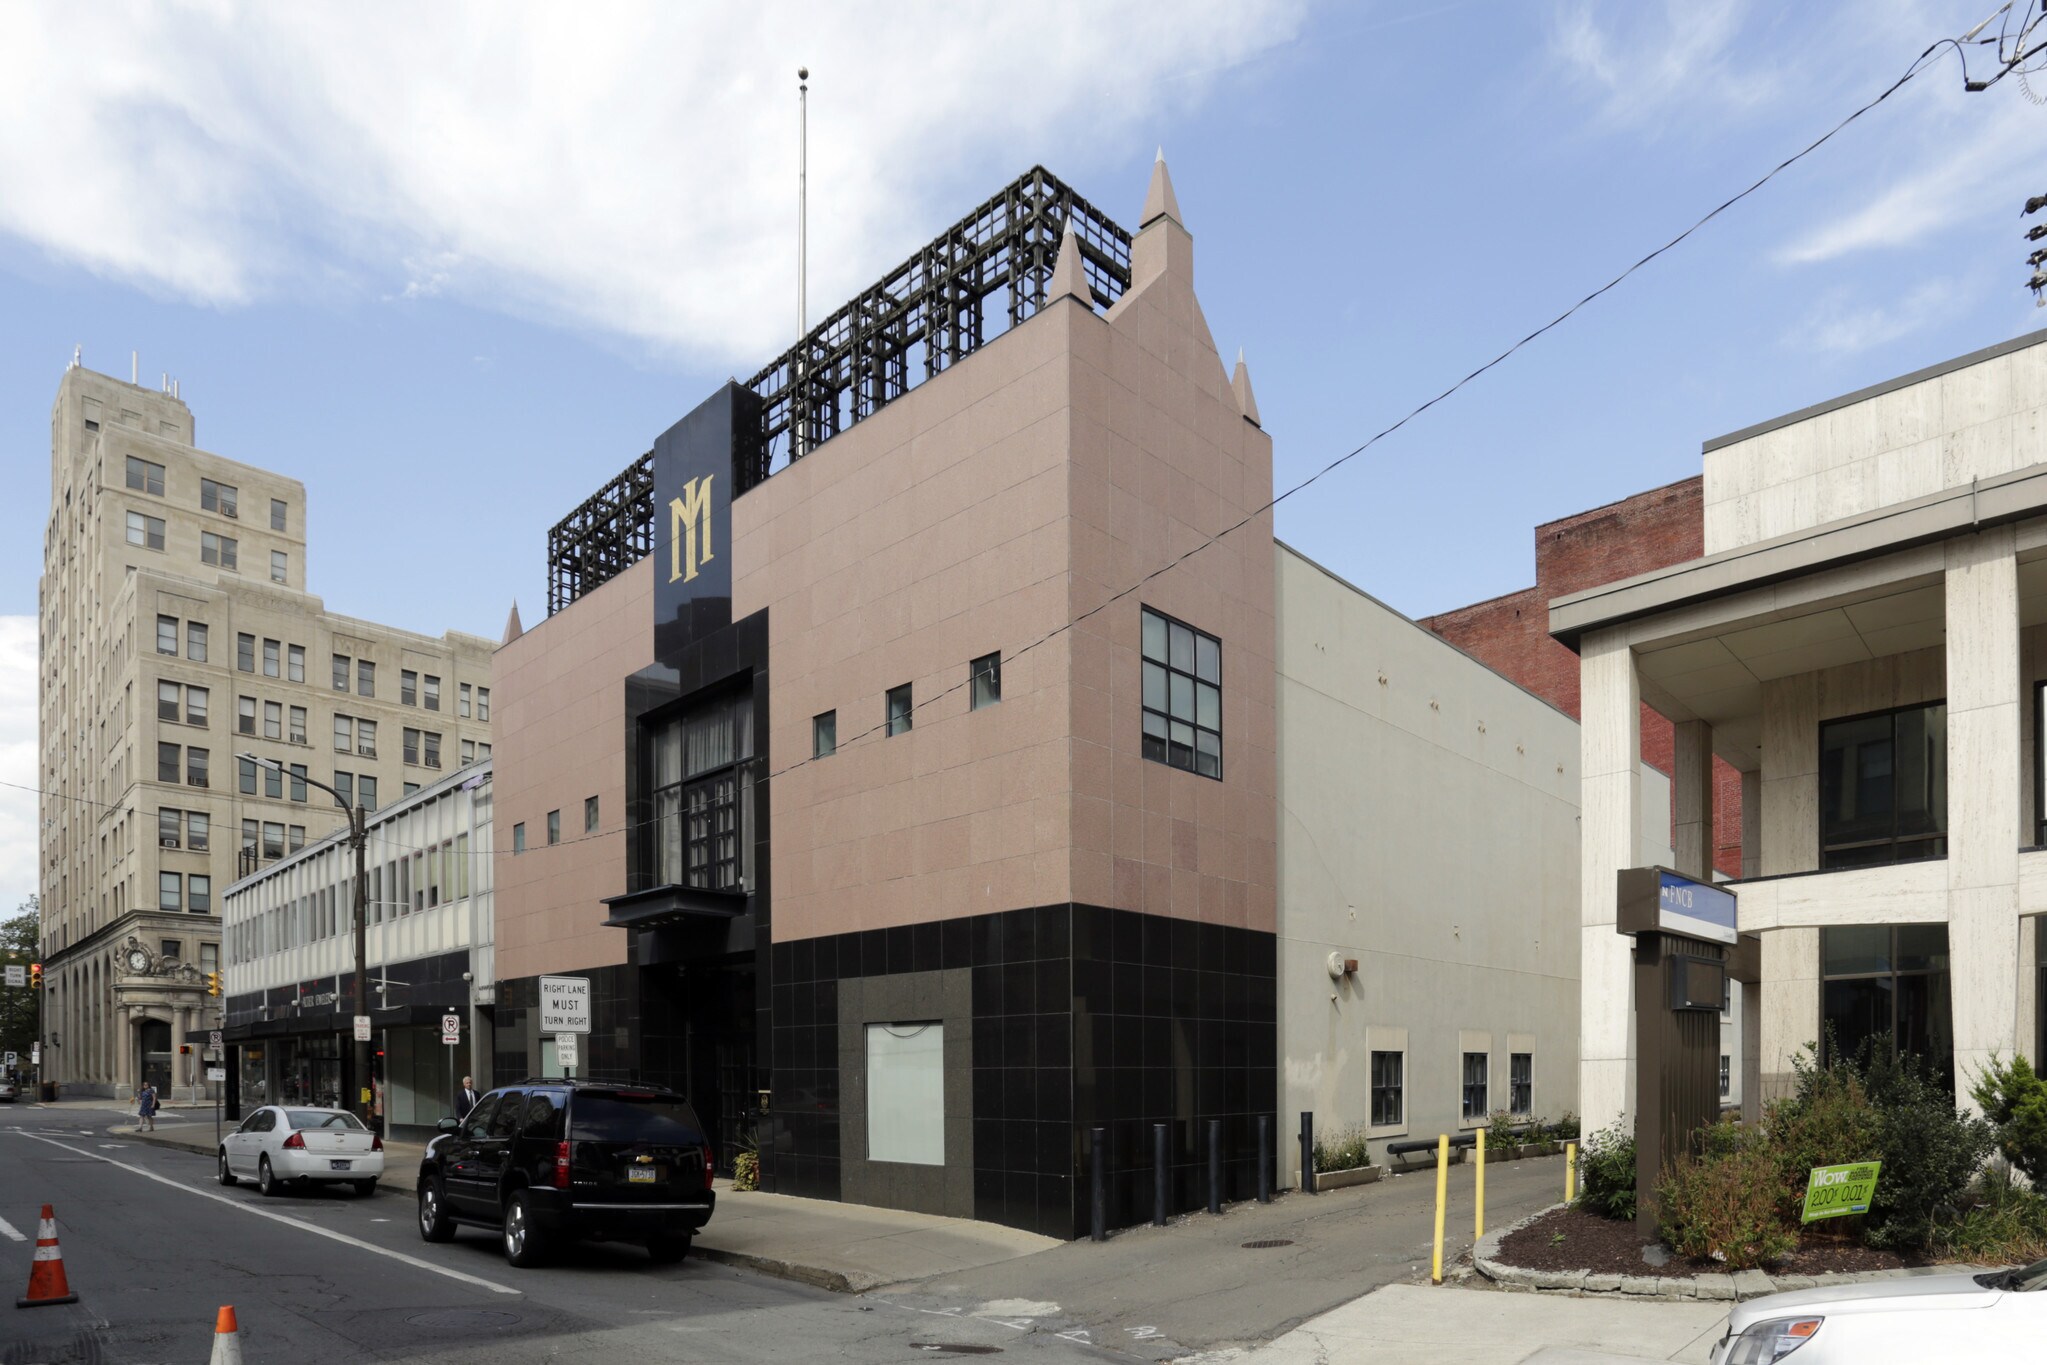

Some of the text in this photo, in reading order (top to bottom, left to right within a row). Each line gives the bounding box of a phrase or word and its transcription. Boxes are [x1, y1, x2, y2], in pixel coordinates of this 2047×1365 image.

[1670, 885, 1693, 909] FNCB
[543, 984, 587, 995] RIGHT LANE
[552, 999, 579, 1010] MUST
[544, 1016, 588, 1026] TURN RIGHT
[7, 1053, 15, 1063] P
